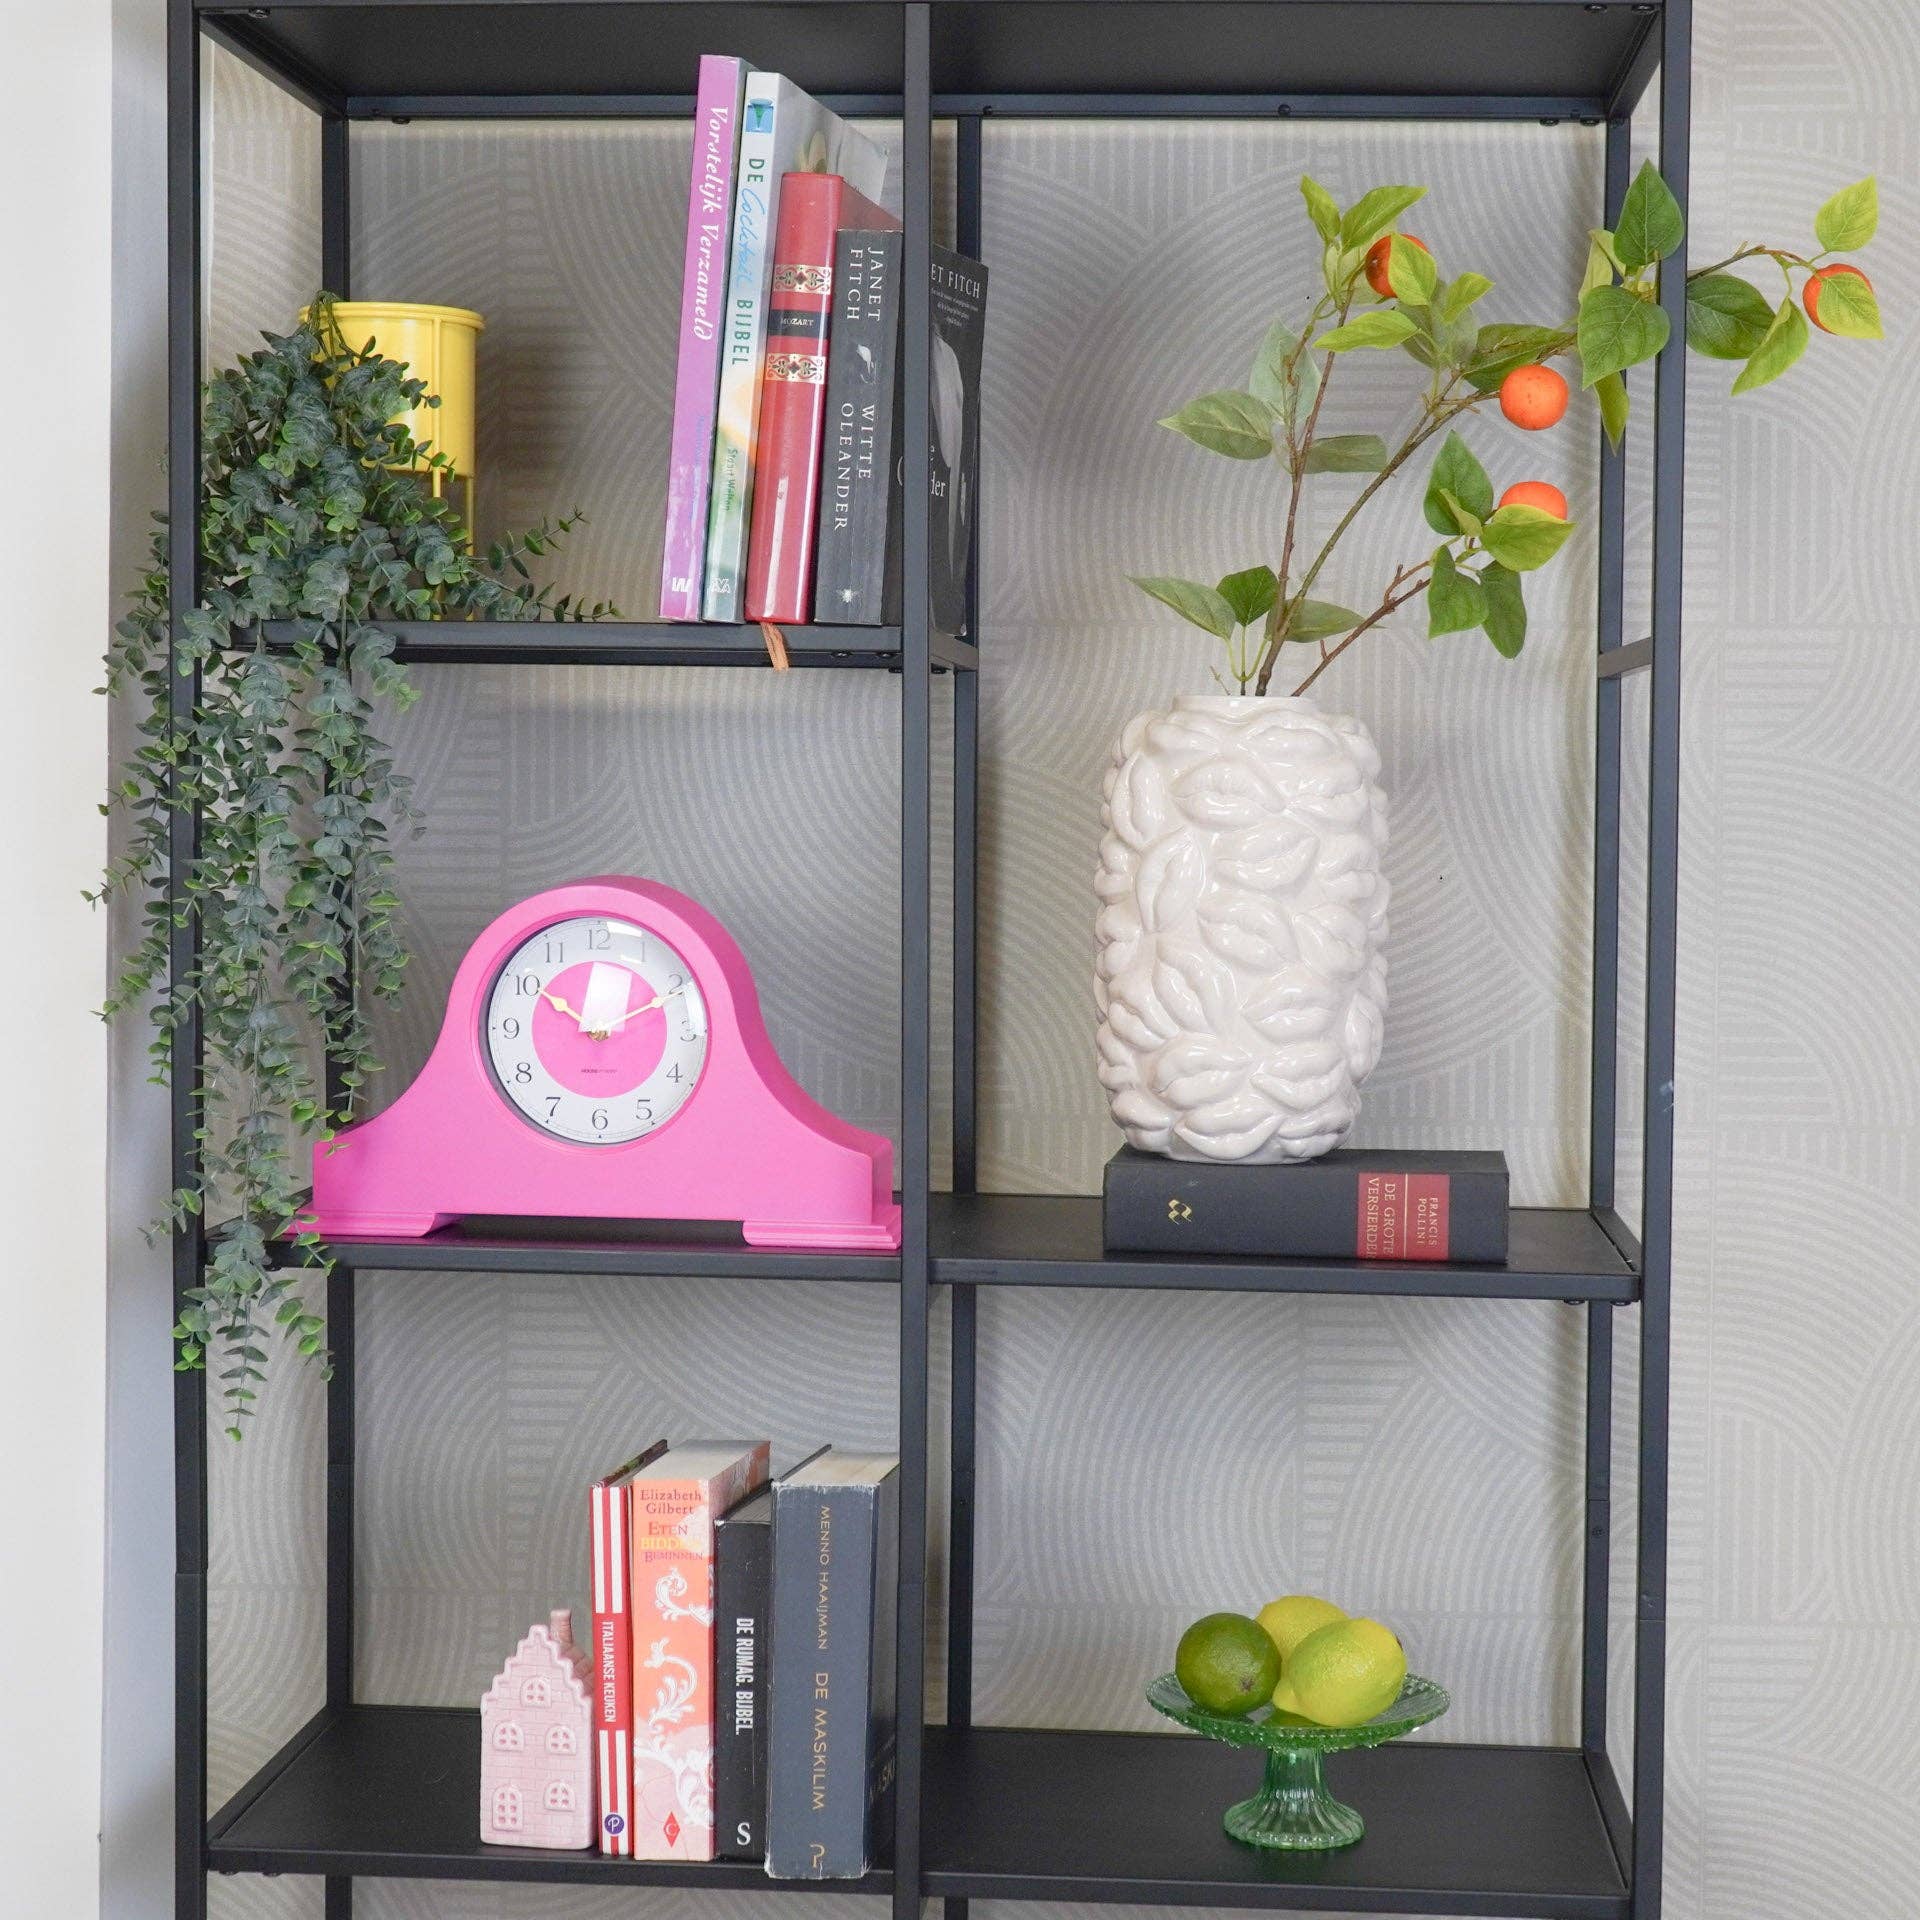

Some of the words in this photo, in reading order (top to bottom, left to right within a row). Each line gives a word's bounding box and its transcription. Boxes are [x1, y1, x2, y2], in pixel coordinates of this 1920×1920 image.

[699, 106, 729, 217] Vorstelijk
[747, 158, 765, 184] DE
[735, 188, 765, 289] Cocktail
[693, 223, 719, 341] Verzameld
[847, 249, 863, 320] FITCH
[867, 247, 884, 321] JANET
[948, 270, 981, 299] FITCH
[731, 299, 753, 366] BIJBEL
[780, 318, 815, 326] MOZART
[858, 404, 875, 479] WITTE
[834, 402, 854, 531] OLEANDER
[545, 942, 564, 963] 11
[586, 929, 611, 950] 12
[641, 941, 647, 962] 1
[515, 974, 541, 996] 10
[668, 973, 684, 996] 2
[503, 1018, 520, 1039] 9
[515, 1062, 532, 1083] 8
[666, 1063, 683, 1083] 4
[545, 1096, 561, 1117] 7
[591, 1109, 608, 1130] 6
[635, 1099, 653, 1120] 5
[1384, 1183, 1396, 1201] DE
[1383, 1207, 1395, 1254] GROTE
[1416, 1198, 1427, 1245] POLLINI
[1427, 1197, 1439, 1247] FRANCIS
[640, 1489, 702, 1502] Elizabeth
[646, 1502, 695, 1515] Gilbert
[819, 1505, 831, 1566] MENNO
[817, 1571, 829, 1650] HAAIJMAN
[736, 1617, 754, 1634] DE
[601, 1621, 615, 1681] ITALIAANSE
[735, 1638, 754, 1687] RUMAG.
[815, 1672, 828, 1700] DE
[603, 1682, 616, 1723] KEUKEN
[735, 1691, 754, 1735] BIJBEL.
[812, 1708, 828, 1810] MASKILIM
[737, 1822, 751, 1846] S
